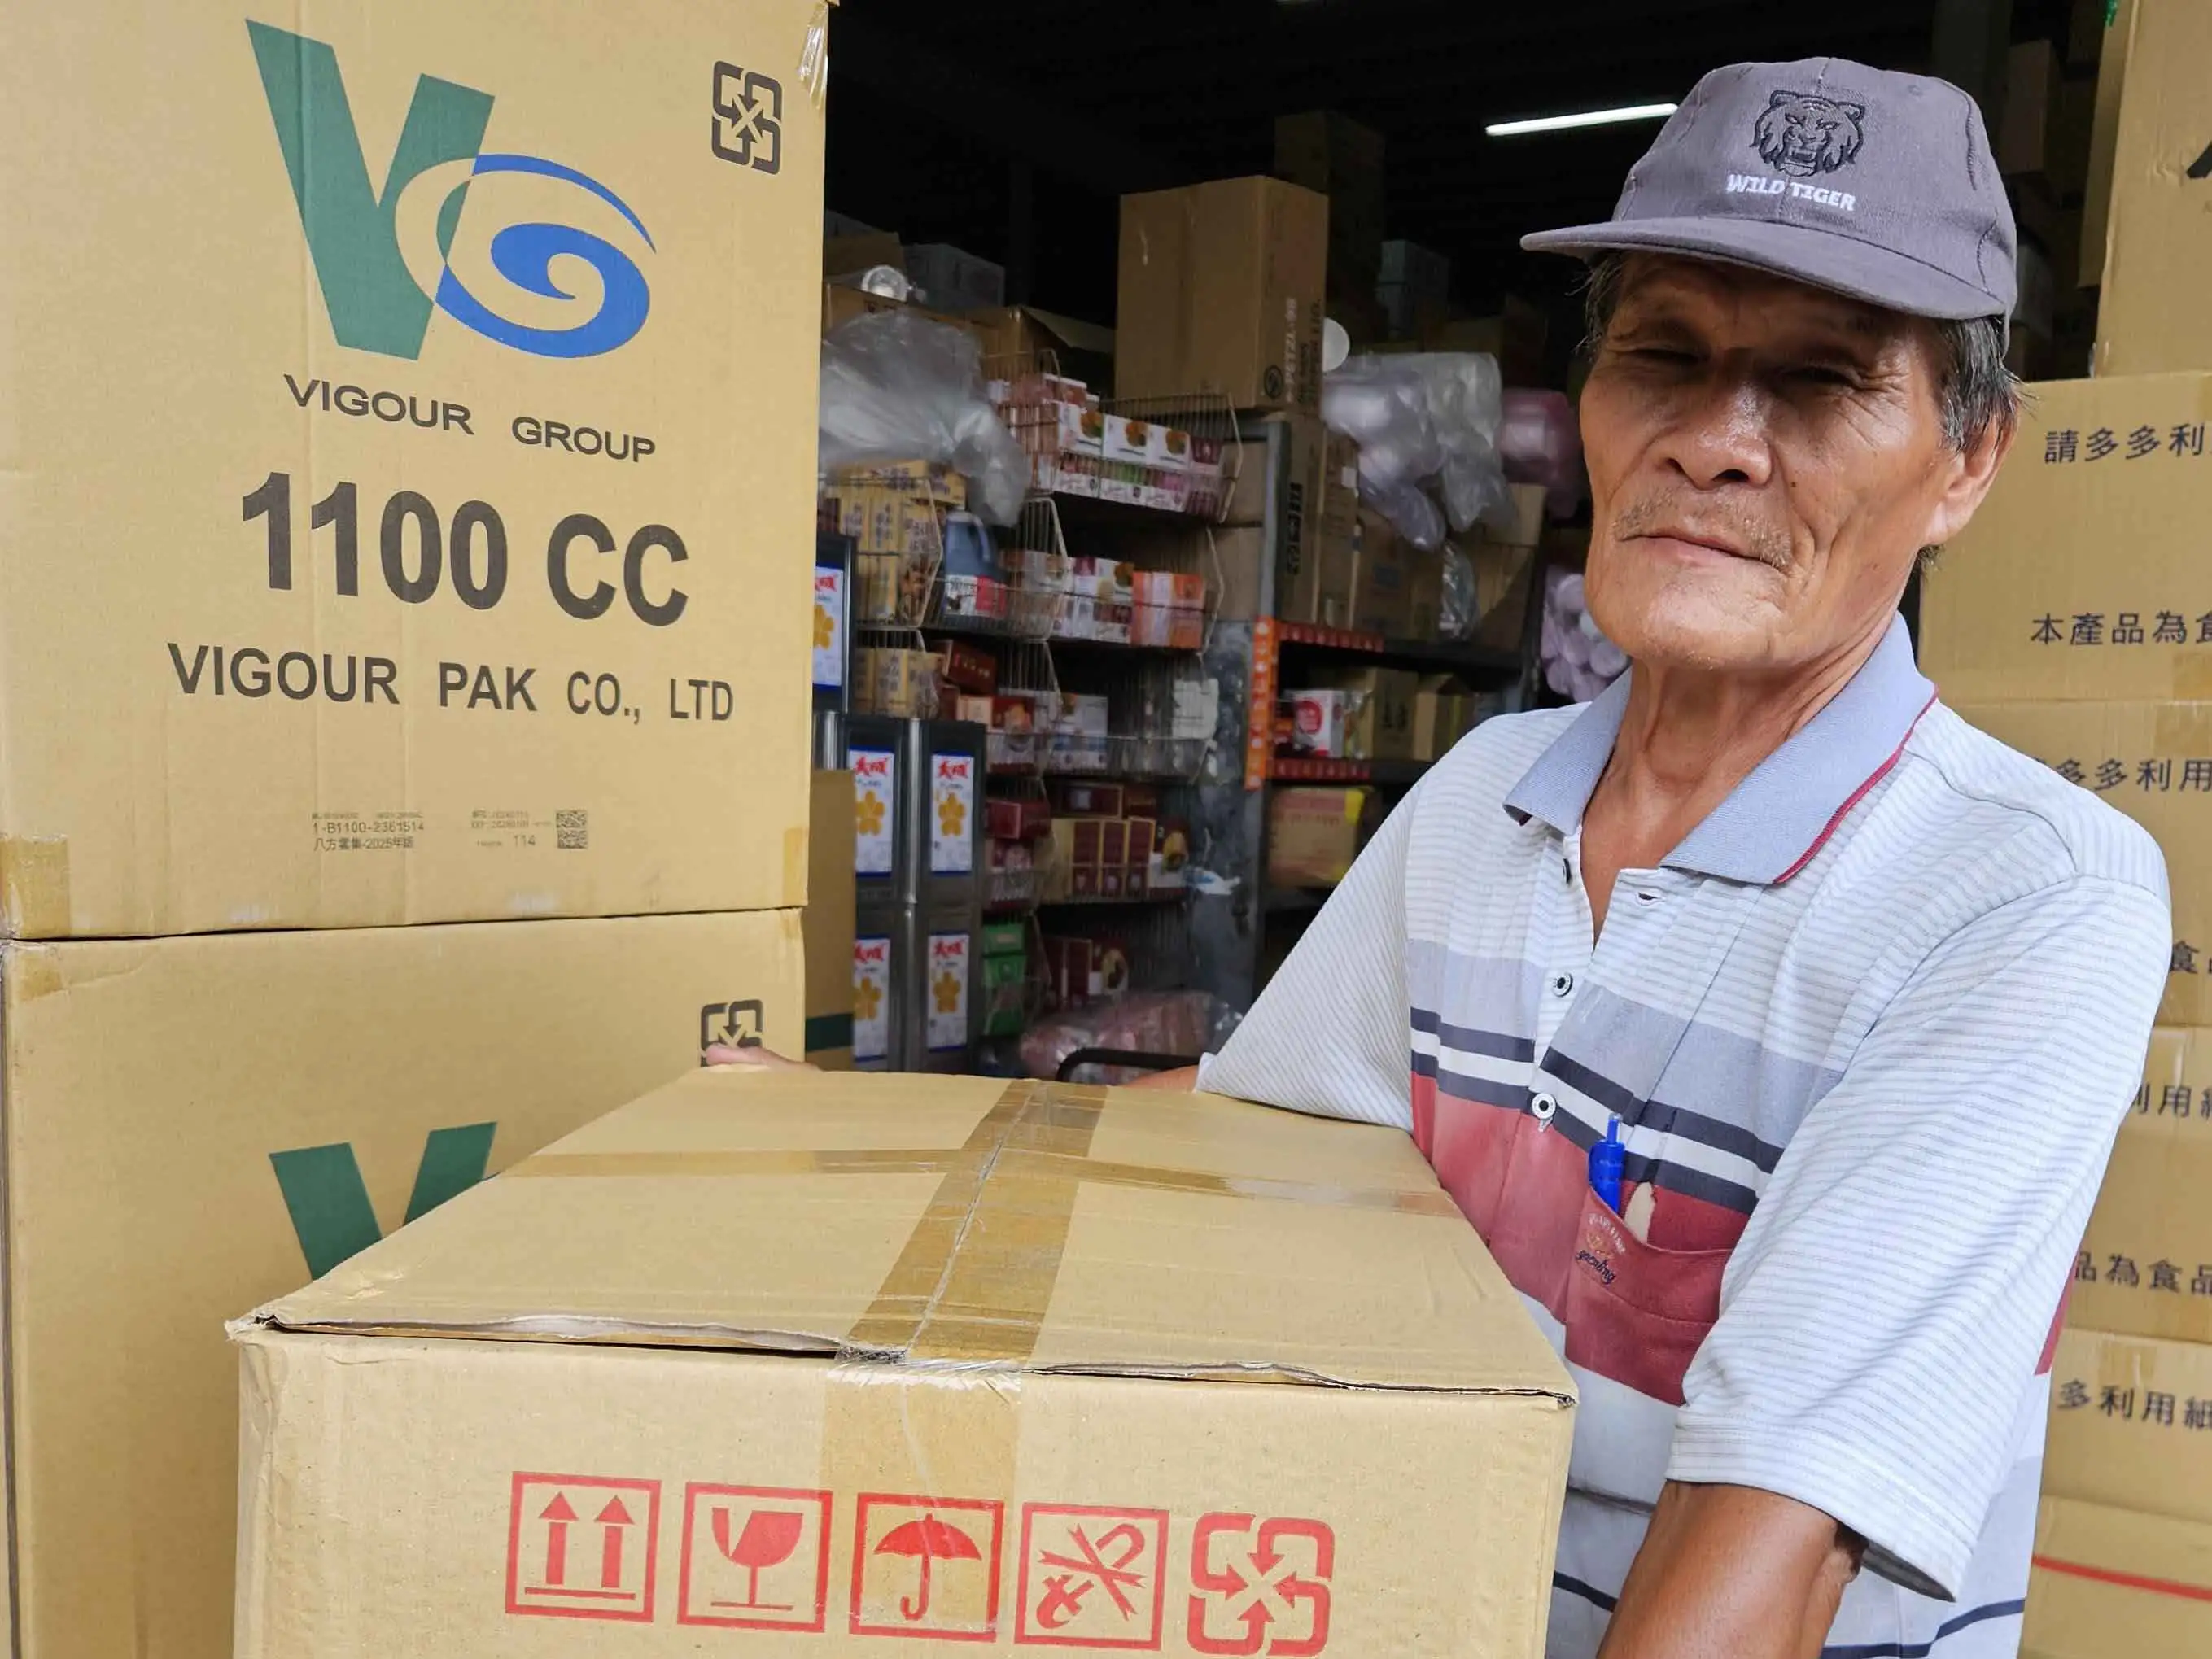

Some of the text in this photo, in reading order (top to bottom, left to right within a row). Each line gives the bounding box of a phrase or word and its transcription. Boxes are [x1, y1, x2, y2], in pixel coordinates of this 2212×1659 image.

[1726, 173, 1856, 212] WILD TIGER
[284, 373, 656, 463] VIGOUR GROUP
[2044, 423, 2212, 464] 請多多利
[242, 471, 689, 626] 1100 CC
[168, 643, 733, 725] VIGOUR PAK CO., LTD
[2034, 757, 2212, 792] 多多利用
